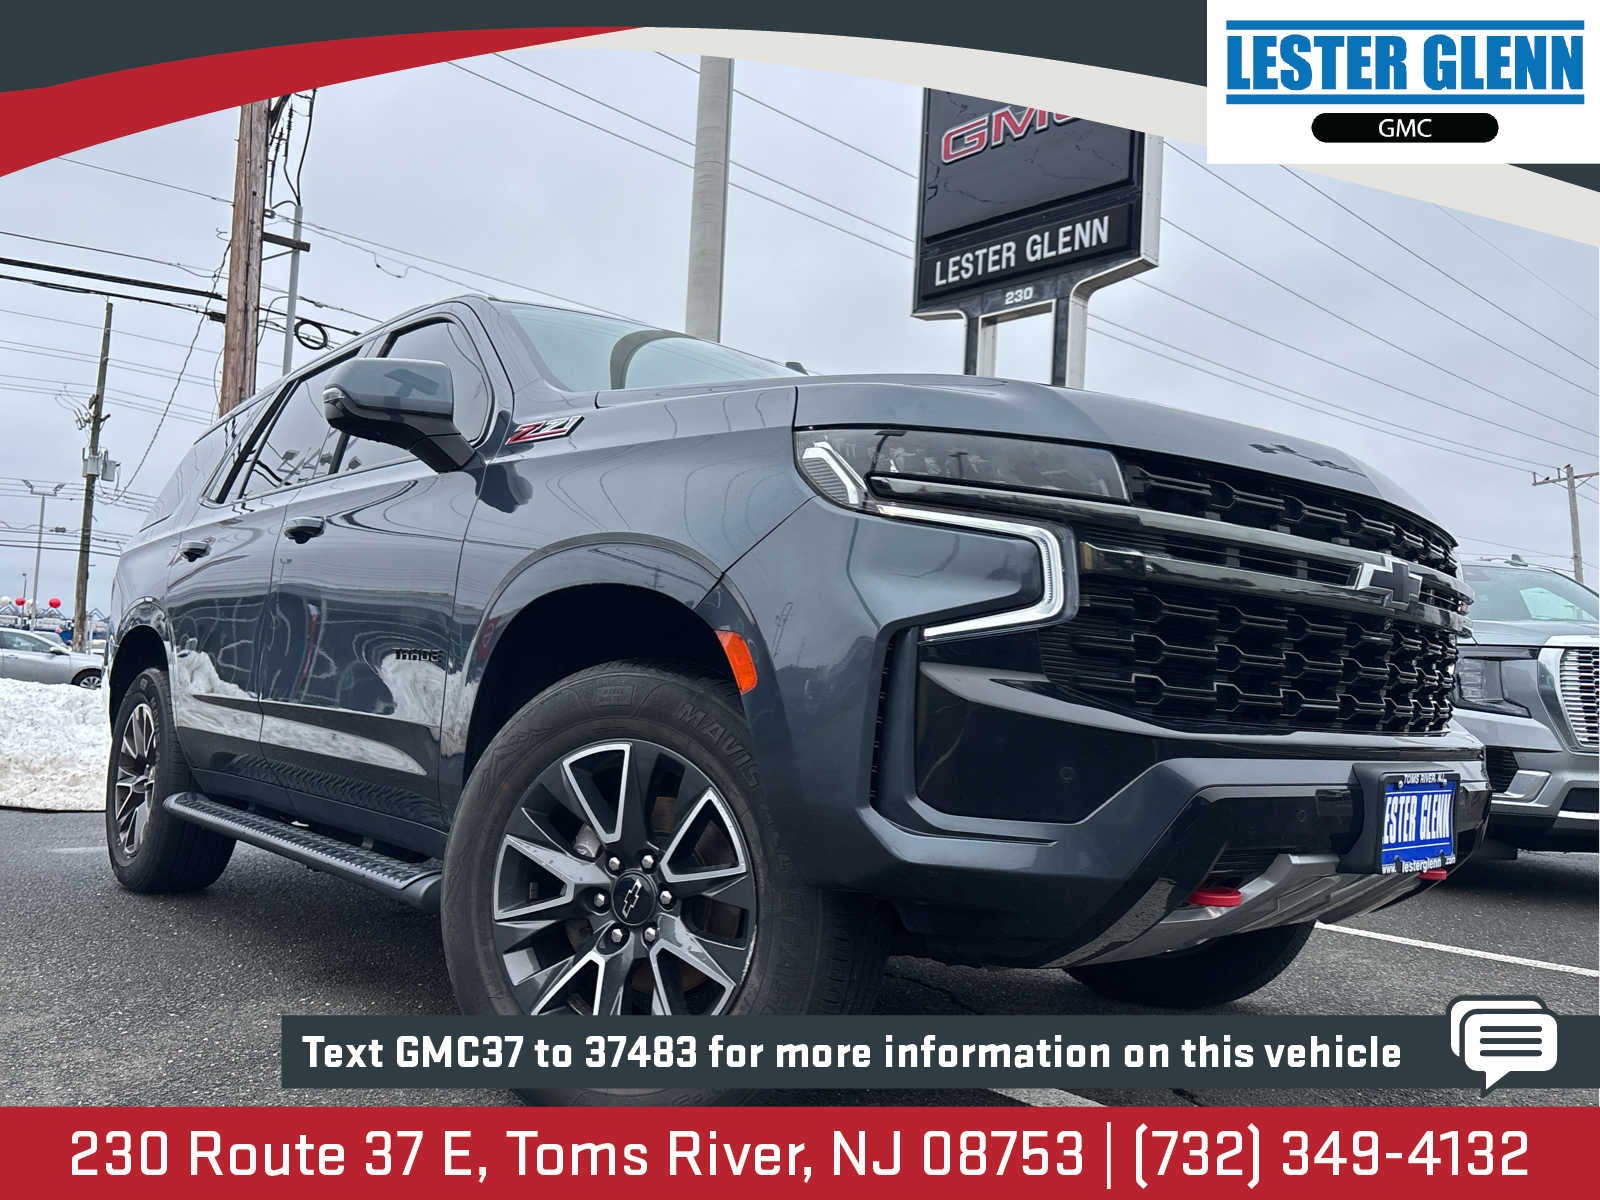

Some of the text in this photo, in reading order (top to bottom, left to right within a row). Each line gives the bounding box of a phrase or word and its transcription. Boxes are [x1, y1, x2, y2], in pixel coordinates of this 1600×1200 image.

[934, 215, 1110, 287] LESTER GLENN
[1004, 286, 1034, 305] 230
[505, 415, 584, 446] Z71
[677, 702, 760, 787] MAVIS
[1404, 773, 1420, 784] TOMS
[1382, 793, 1452, 844] ESTER GLENN
